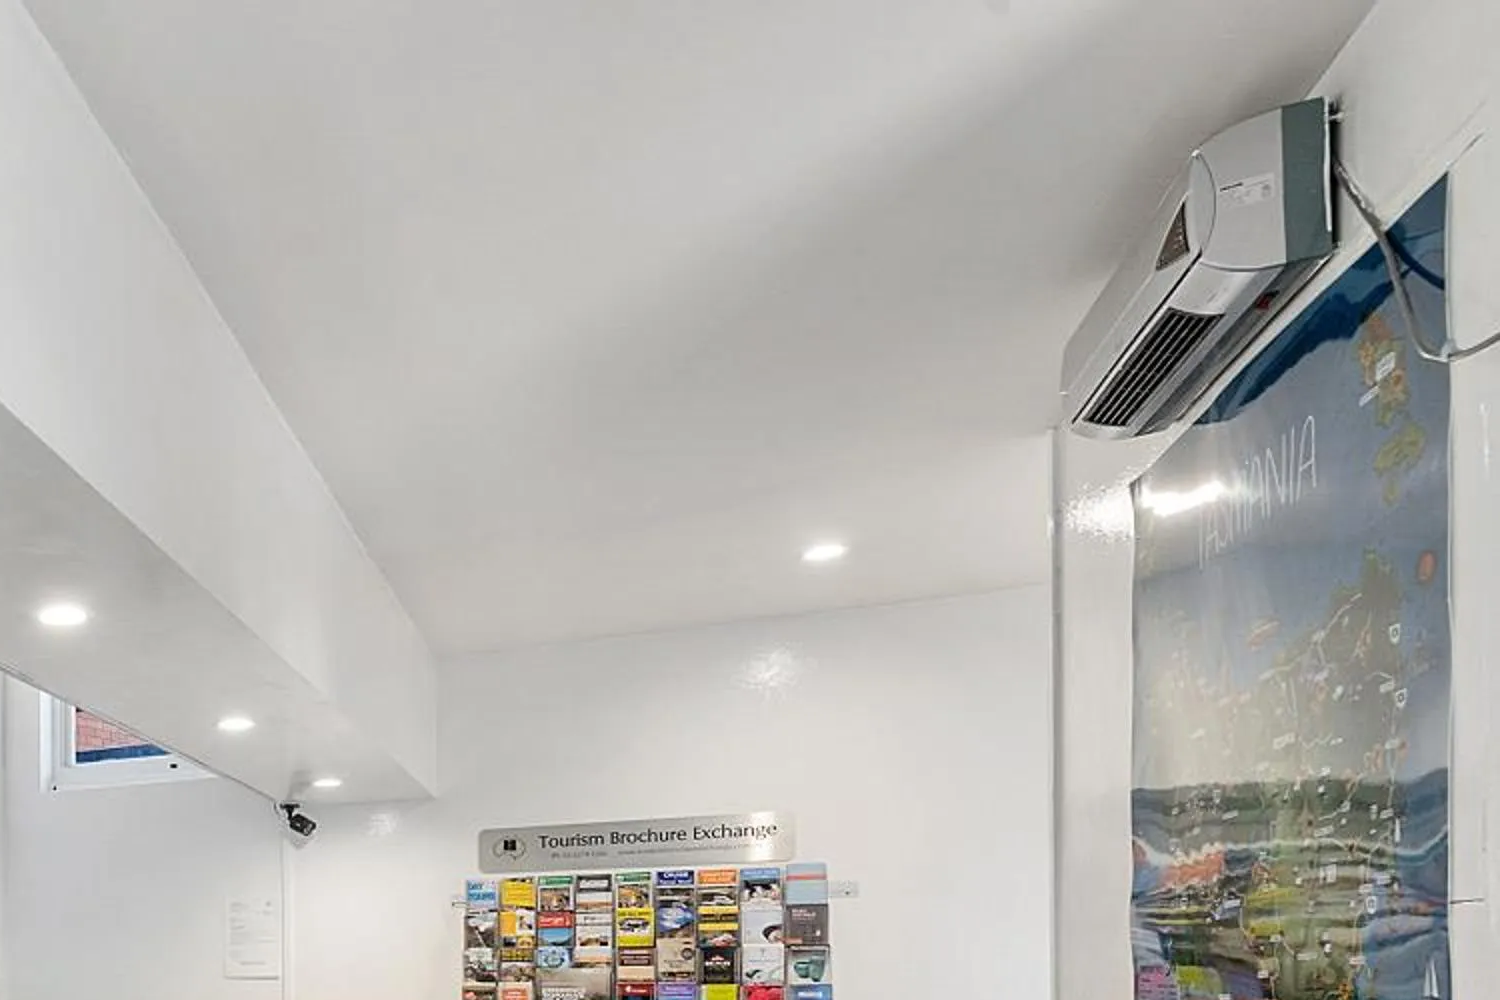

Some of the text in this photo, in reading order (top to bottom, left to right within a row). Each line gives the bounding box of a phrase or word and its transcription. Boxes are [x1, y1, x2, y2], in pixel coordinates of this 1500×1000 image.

[537, 834, 605, 850] Tourism
[610, 828, 687, 847] Brochure
[693, 822, 778, 844] Exchange
